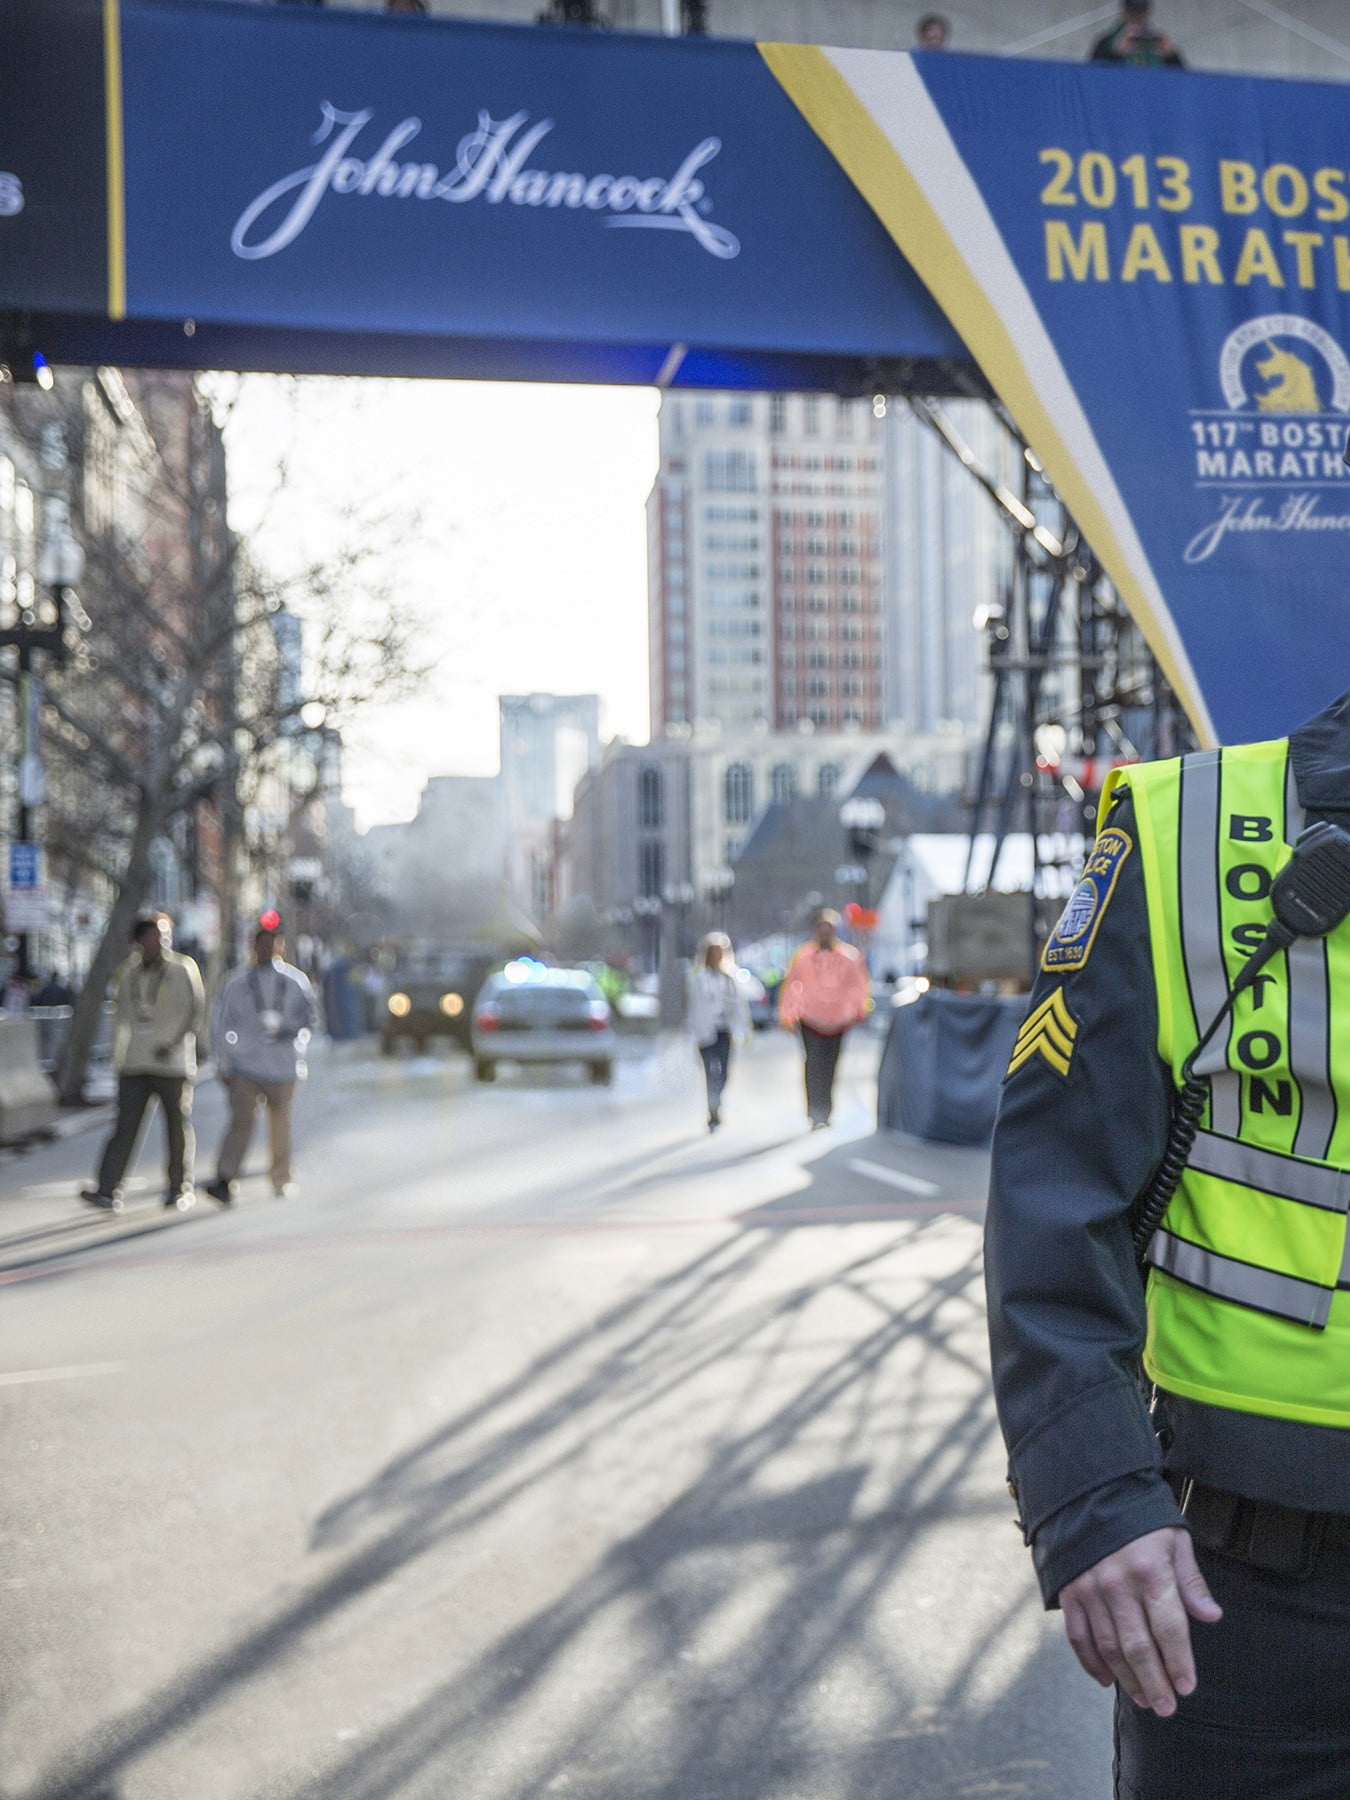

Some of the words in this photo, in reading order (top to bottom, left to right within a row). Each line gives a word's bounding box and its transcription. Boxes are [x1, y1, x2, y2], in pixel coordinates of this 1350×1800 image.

[230, 99, 441, 260] John
[437, 106, 741, 260] Hancock
[1038, 147, 1193, 213] 2013
[1184, 495, 1275, 565] John
[1095, 837, 1124, 857] TON
[1225, 814, 1293, 1117] BOSTON
